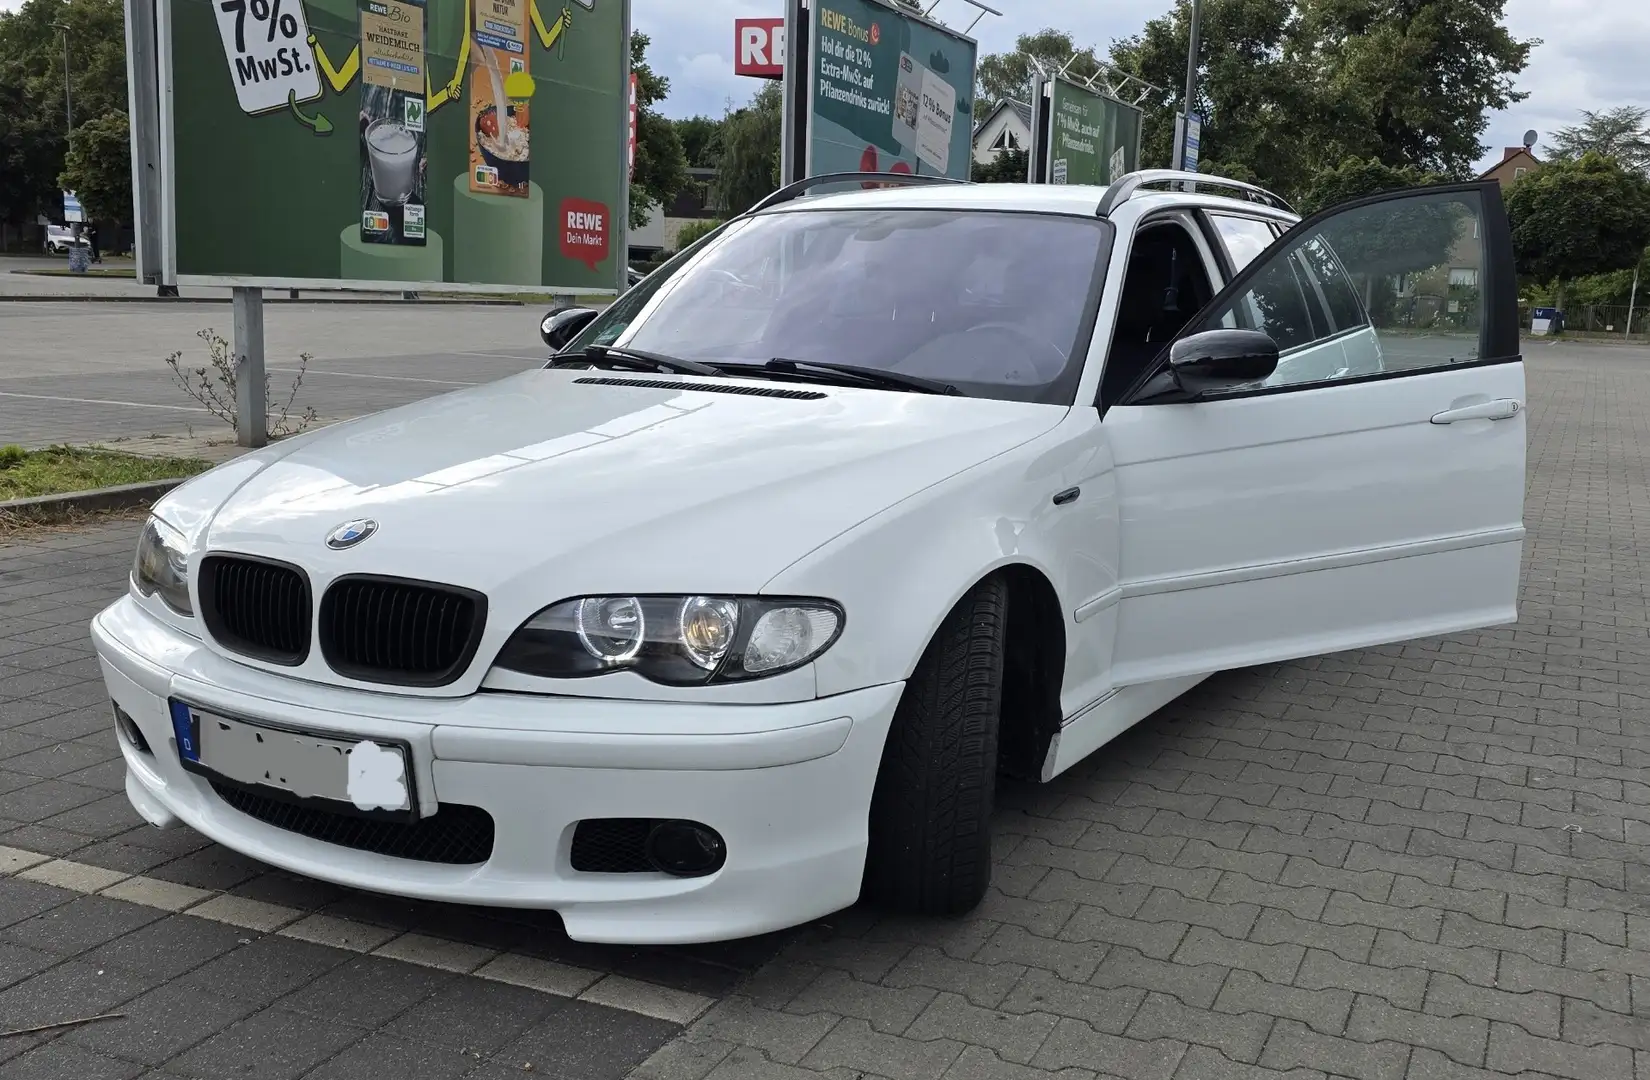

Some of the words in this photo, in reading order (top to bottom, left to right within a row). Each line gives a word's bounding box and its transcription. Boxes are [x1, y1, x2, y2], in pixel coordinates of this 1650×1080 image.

[370, 3, 387, 15] REWE
[388, 6, 411, 23] Bio
[220, 0, 298, 53] 7%
[821, 8, 847, 34] REWE
[847, 18, 869, 42] Bonus
[366, 32, 420, 53] WEIDEMILCH
[821, 35, 834, 55] Hol
[834, 41, 844, 58] dir
[845, 45, 855, 62] die
[235, 47, 311, 86] MwSt.
[863, 74, 874, 90] auf
[820, 78, 868, 108] Pflanzendrinks
[867, 96, 890, 115] zurück!
[567, 211, 603, 231] REWE
[566, 231, 582, 244] Dein
[582, 233, 603, 246] Markt
[183, 737, 191, 751] D
